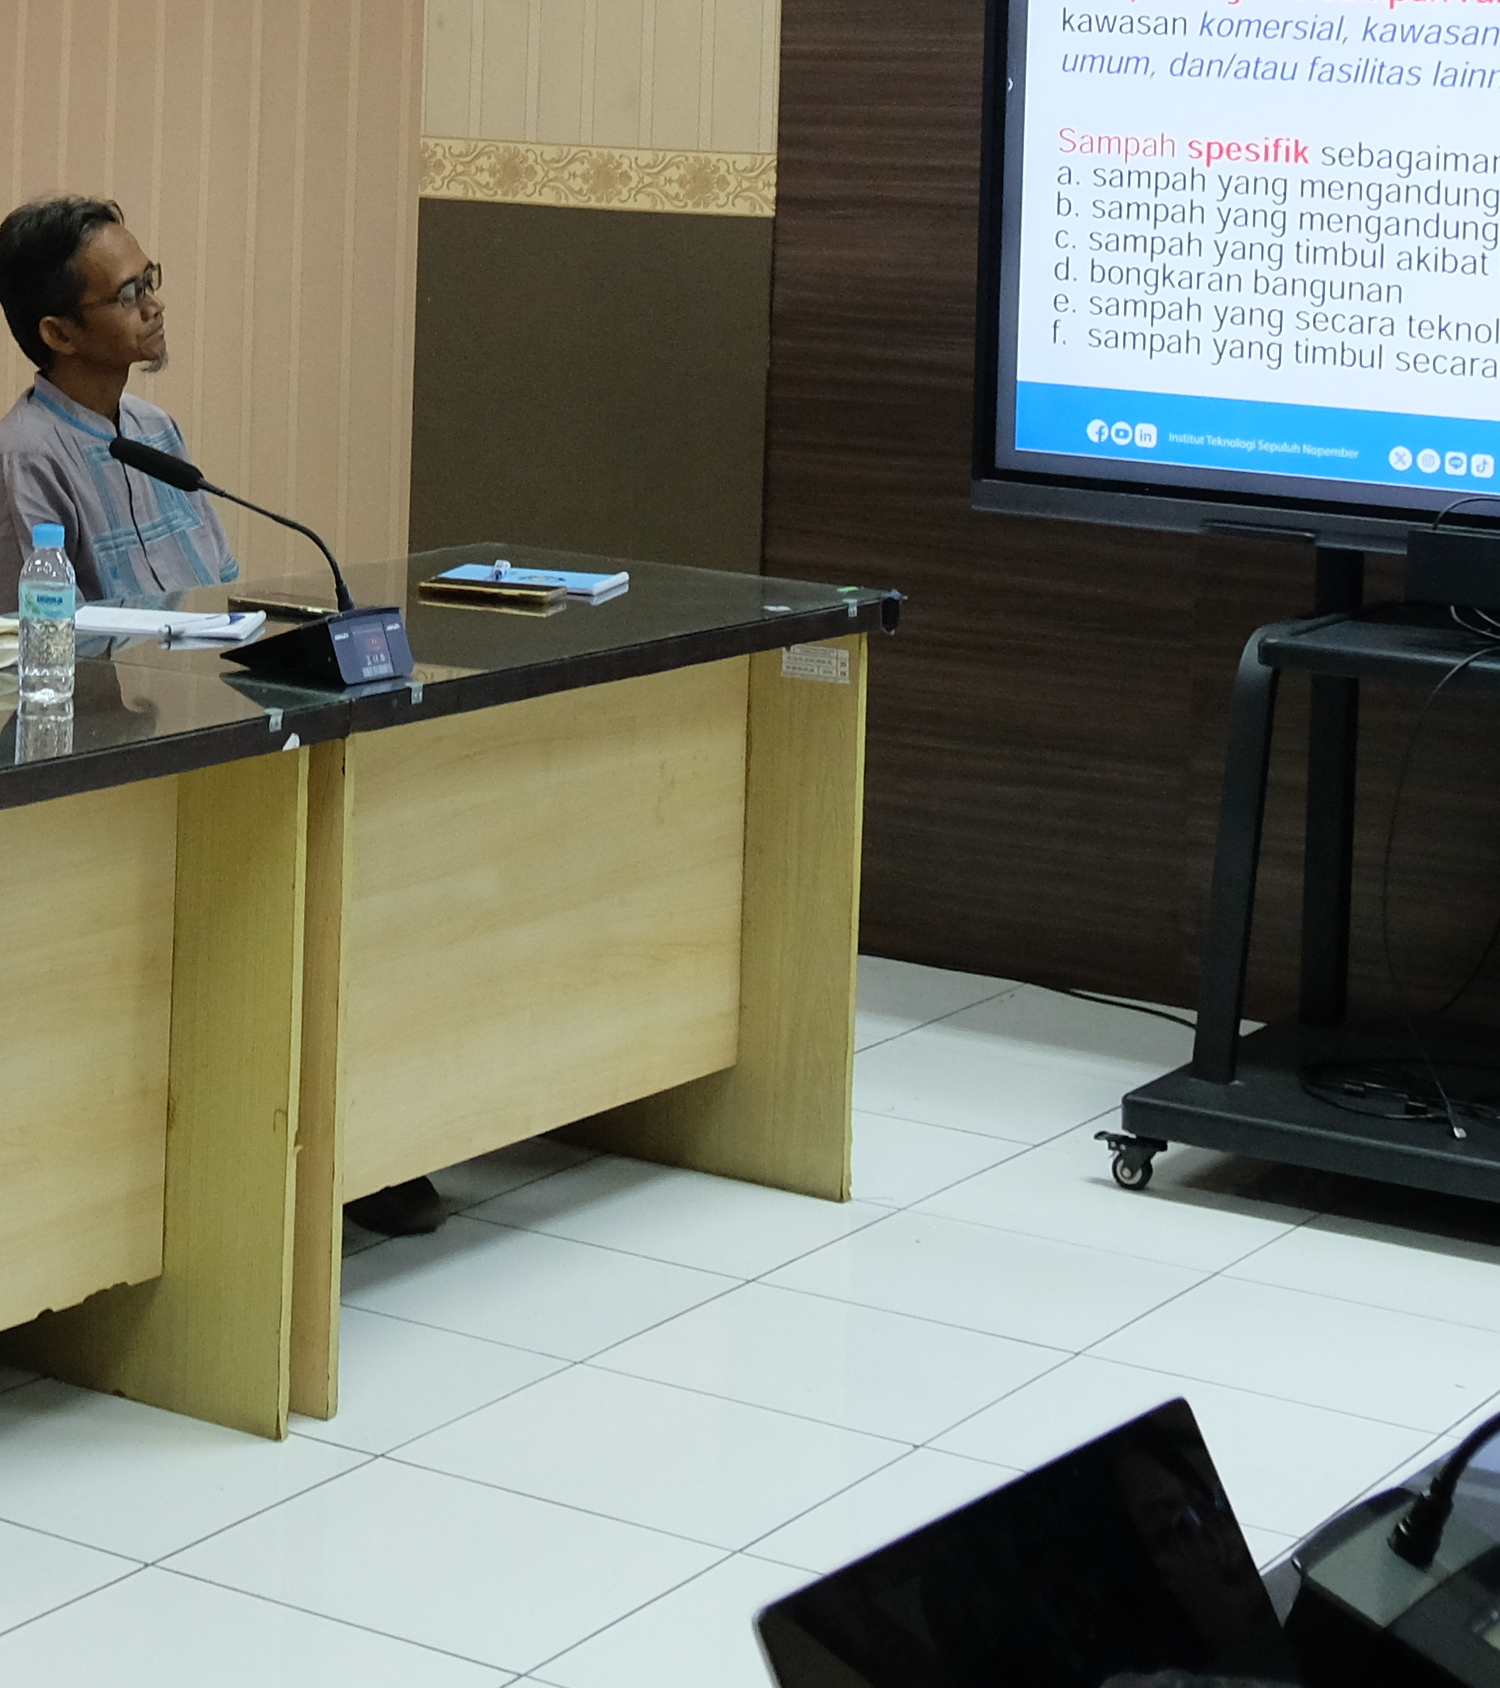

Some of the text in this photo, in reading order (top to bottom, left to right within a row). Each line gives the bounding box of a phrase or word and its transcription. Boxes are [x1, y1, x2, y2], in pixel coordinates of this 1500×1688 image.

[1062, 7, 1188, 36] kawasan
[1199, 11, 1349, 44] komersial,
[1362, 16, 1500, 46] kawasan
[1061, 54, 1155, 78] umum,
[1169, 52, 1298, 81] dan/atau
[1308, 56, 1422, 86] fasilitas
[1058, 128, 1175, 163] Sampah
[1187, 137, 1310, 167] spesifik
[1056, 166, 1081, 185] a.
[1093, 167, 1206, 198] sampah
[1216, 175, 1288, 205] yang
[1300, 179, 1500, 217] mengandung
[1055, 191, 1080, 217] b.
[1092, 199, 1205, 230] sampah
[1215, 207, 1287, 238] yang
[1299, 212, 1499, 251] mengandung
[1054, 230, 1078, 249] c.
[1089, 232, 1203, 263] sampah
[1212, 240, 1284, 271] yang
[1295, 238, 1385, 269] timbul
[1397, 246, 1489, 276] akibat
[1054, 256, 1403, 307] d. bongkaran bangunan
[1053, 294, 1077, 313] e.
[1089, 296, 1202, 327] sampah
[1212, 305, 1284, 337] yang
[1295, 311, 1396, 341] secara
[1051, 319, 1068, 345] f.
[1088, 328, 1201, 360] sampah
[1211, 338, 1283, 370] yang
[1293, 338, 1384, 369] timbul
[1396, 352, 1498, 378] secara
[1169, 432, 1359, 459] Institut Teknologi Sepuluh Nopember
